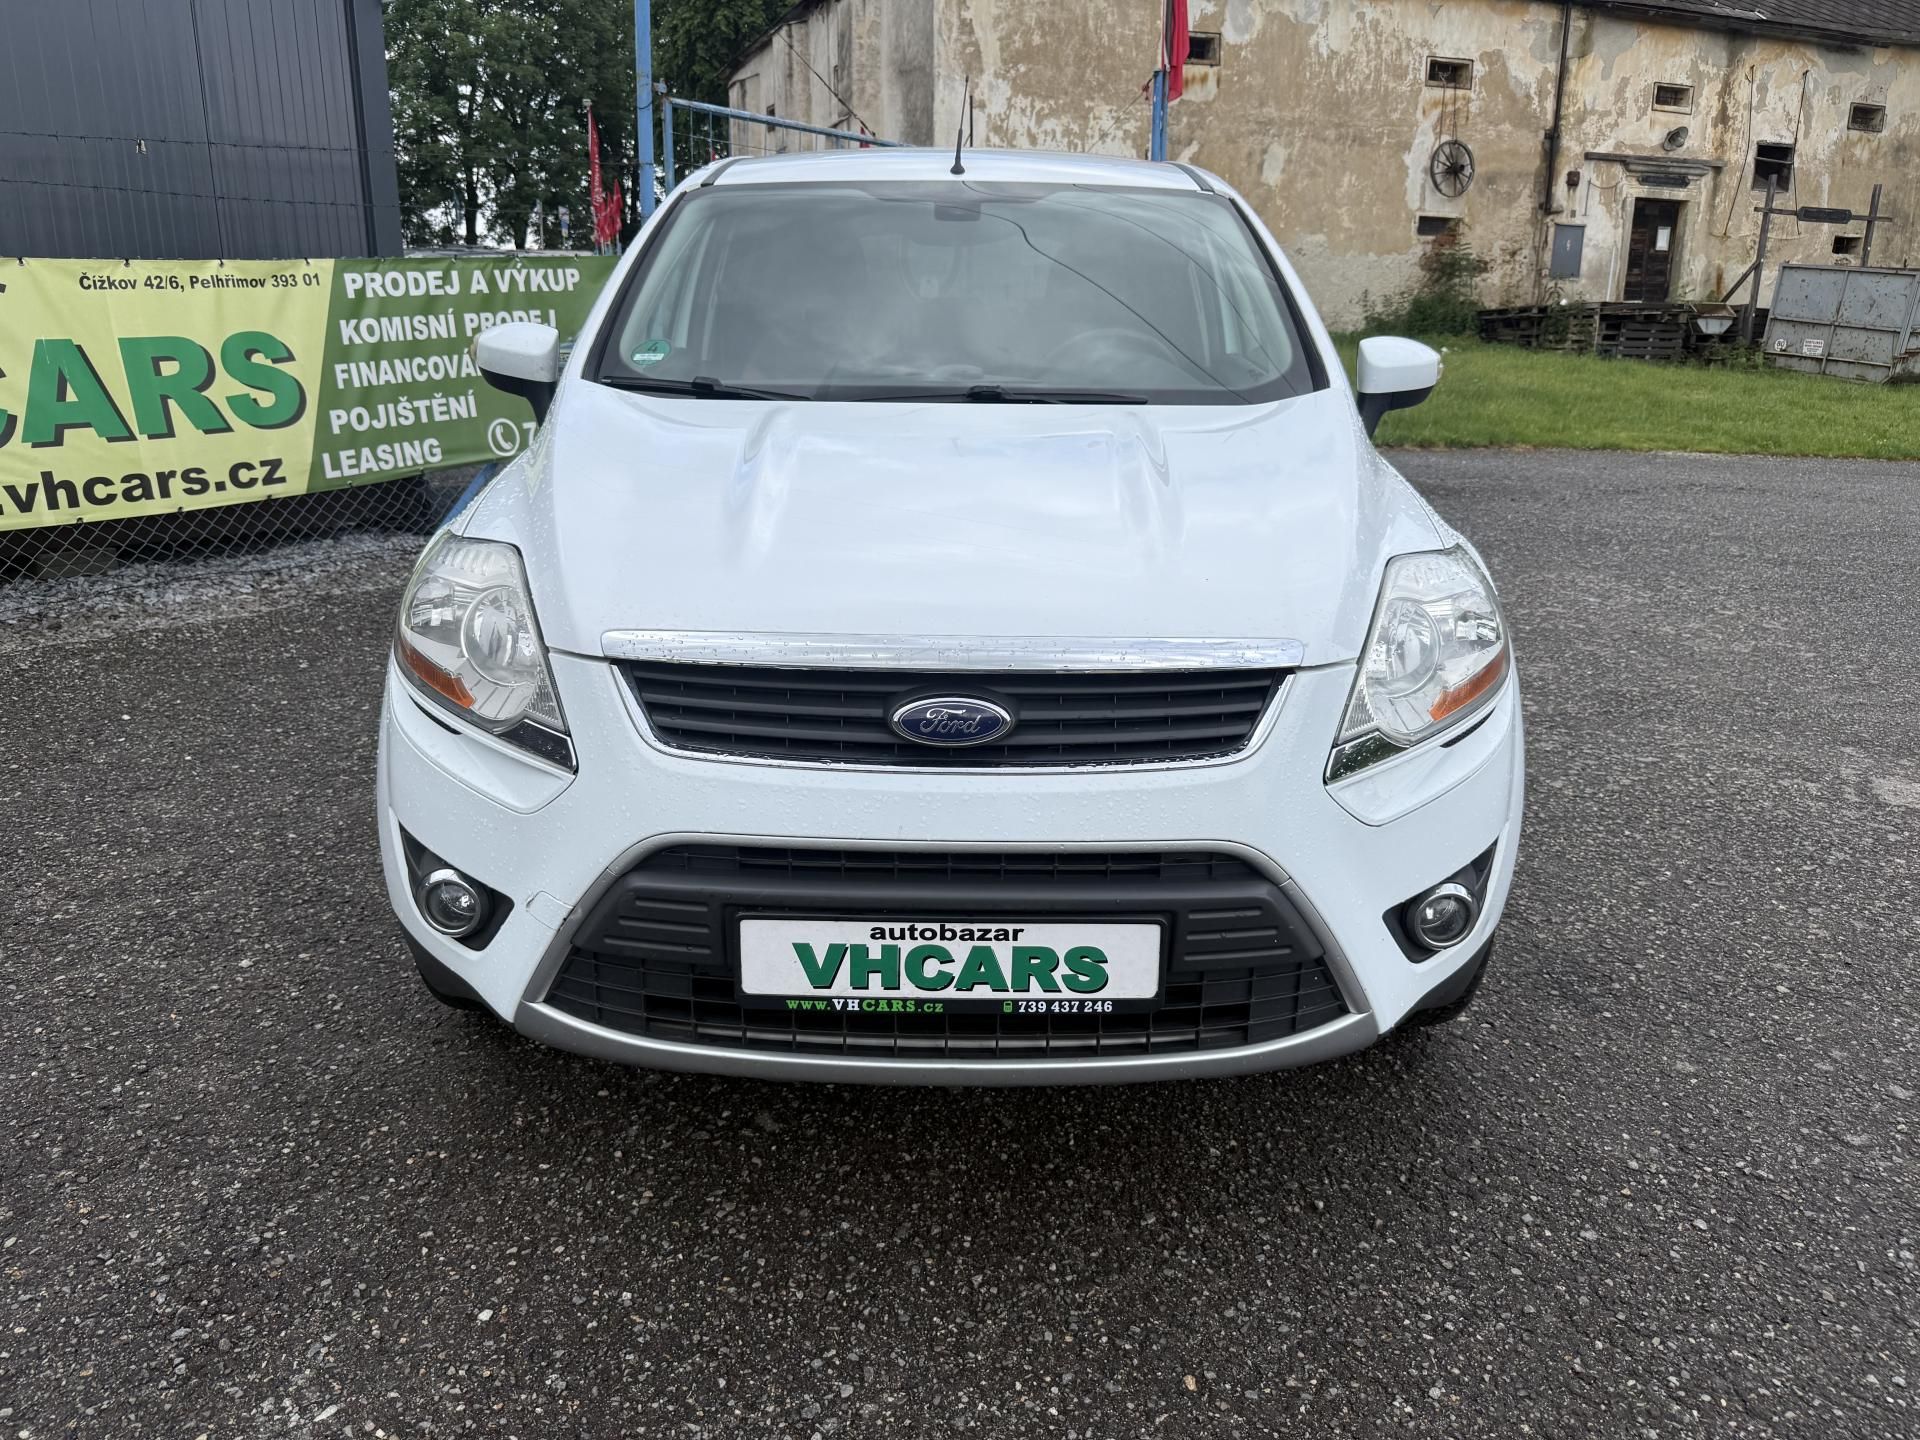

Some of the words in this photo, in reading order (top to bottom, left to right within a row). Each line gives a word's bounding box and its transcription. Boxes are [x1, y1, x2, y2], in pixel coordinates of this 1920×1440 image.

[79, 272, 137, 291] Čížkov
[143, 274, 185, 293] 42/6,
[189, 273, 266, 290] Pelhřimov
[271, 273, 298, 288] 393
[303, 272, 321, 287] 01
[343, 270, 460, 300] PRODEJ
[469, 270, 490, 295] A
[494, 262, 582, 294] VÝKUP
[339, 308, 457, 346] KOMISNÍ
[334, 347, 483, 390] FINANCOVÁ
[0, 330, 307, 448] ARS
[328, 389, 478, 435] POJIŠTĚNÍ
[322, 438, 443, 479] LEASING
[919, 707, 983, 734] Ford
[869, 923, 1025, 942] autobazar
[791, 942, 1109, 993] VHCARS
[785, 998, 944, 1012] www.VHCARS.cz
[1018, 1001, 1047, 1013] 739
[1050, 1001, 1079, 1013] 437
[1083, 1001, 1113, 1013] 246
